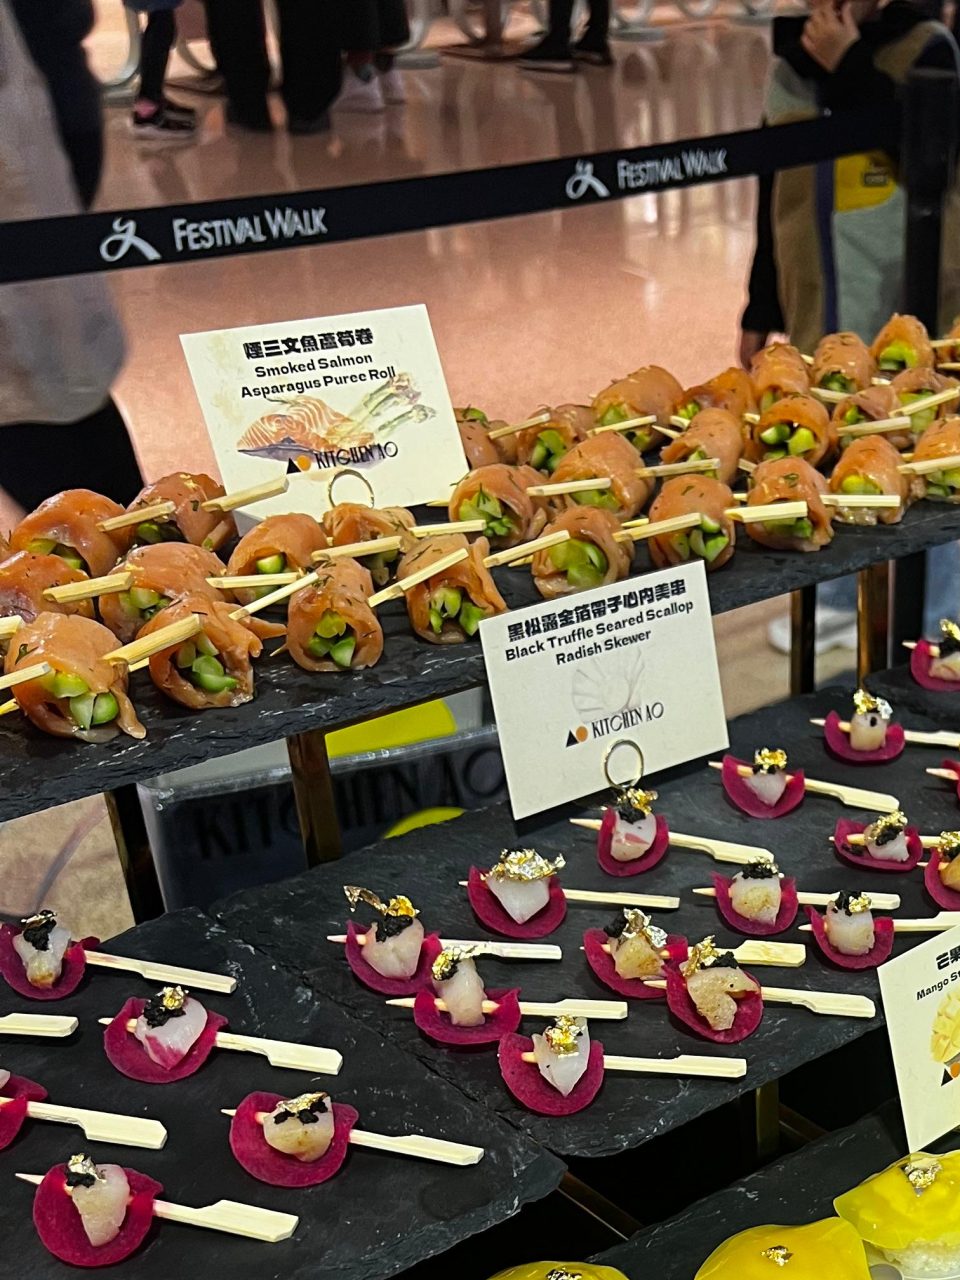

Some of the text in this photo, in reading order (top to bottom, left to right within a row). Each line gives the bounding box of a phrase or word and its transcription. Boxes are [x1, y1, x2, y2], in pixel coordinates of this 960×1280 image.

[616, 148, 728, 189] FESTIVAL WALK
[172, 207, 328, 251] FESTIVAL WALK
[241, 365, 397, 399] Asparagus Puree Roll
[254, 354, 373, 378] Smoked Salmon
[314, 441, 399, 470] KITCHEN AO
[505, 600, 694, 662] Black Truffle Seared Scallop
[556, 630, 652, 666] Radish Skewer
[591, 702, 664, 739] KITCHEN AO
[916, 978, 949, 1001] Mango
